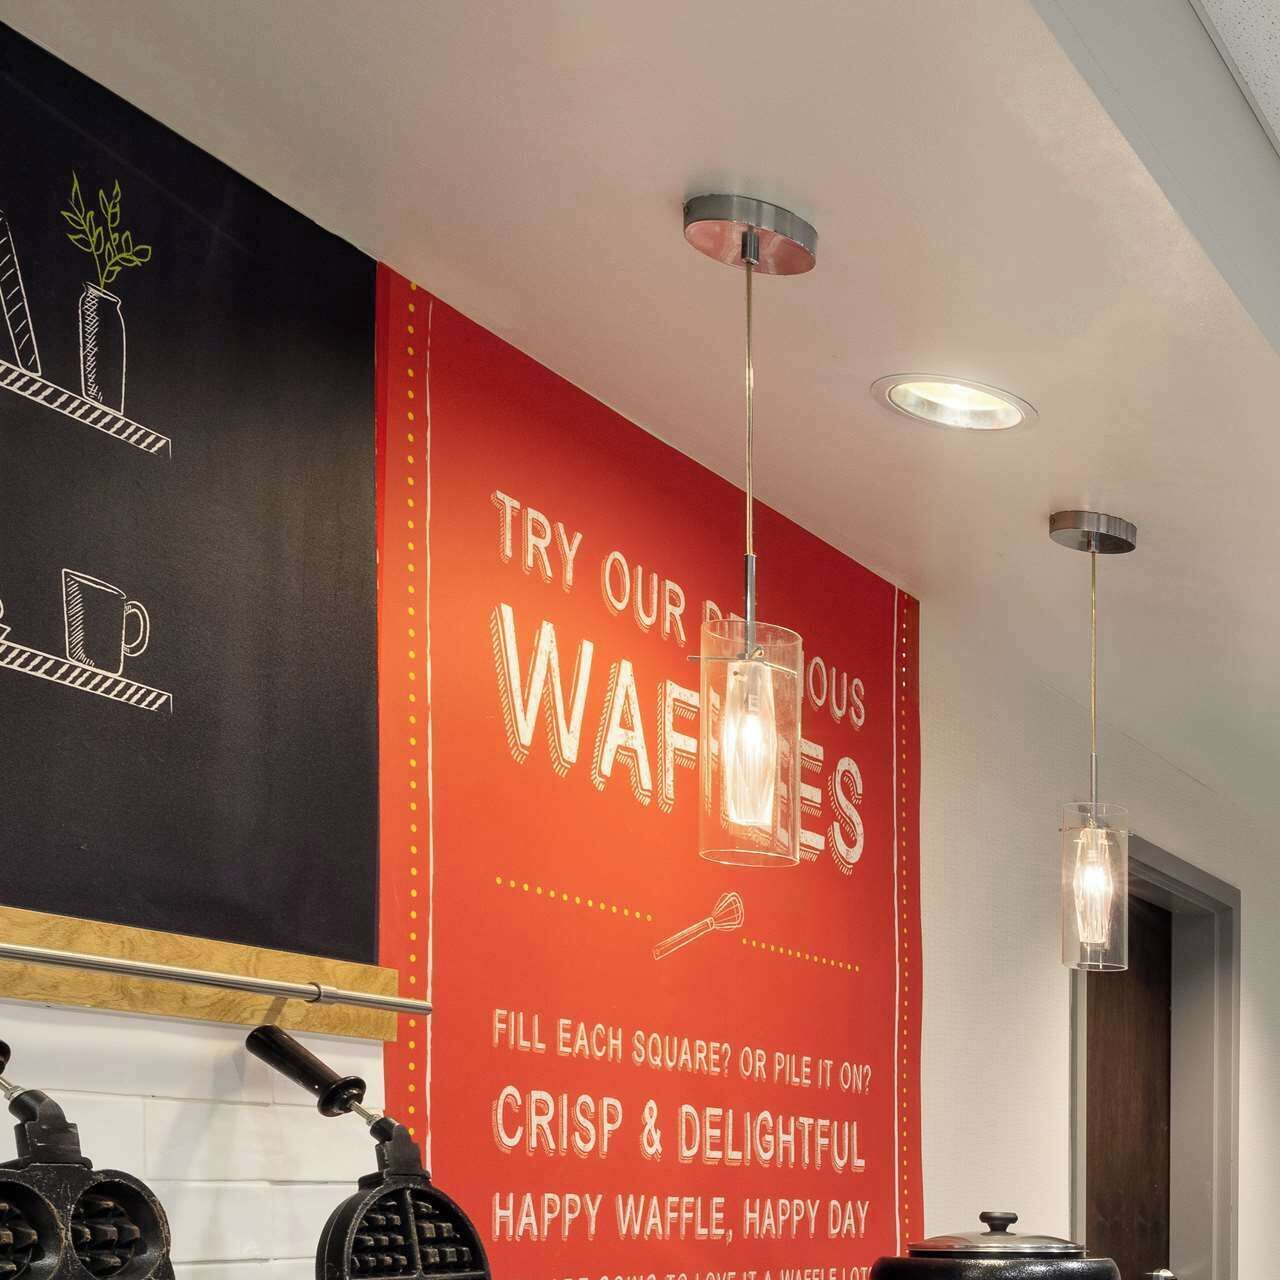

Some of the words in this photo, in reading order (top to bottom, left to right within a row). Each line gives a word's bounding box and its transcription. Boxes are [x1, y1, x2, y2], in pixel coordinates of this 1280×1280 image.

[490, 489, 584, 594] TRY
[602, 549, 687, 648] OUR
[488, 601, 866, 877] WAFFES
[492, 1008, 547, 1052] FILL
[556, 1017, 623, 1064] EACH
[631, 1029, 732, 1078] SQUARE?
[738, 1046, 767, 1081] OR
[773, 1051, 812, 1088] PILE
[817, 1058, 834, 1091] IT
[839, 1062, 872, 1097] ON?
[492, 1085, 623, 1161] CRISP
[639, 1099, 663, 1163] &
[678, 1103, 867, 1174] DELIGHTFUL
[491, 1191, 603, 1242] HAPPY
[615, 1195, 734, 1246] WAFFLE,
[742, 1198, 820, 1241] HAPPY
[828, 1199, 870, 1240] DAY
